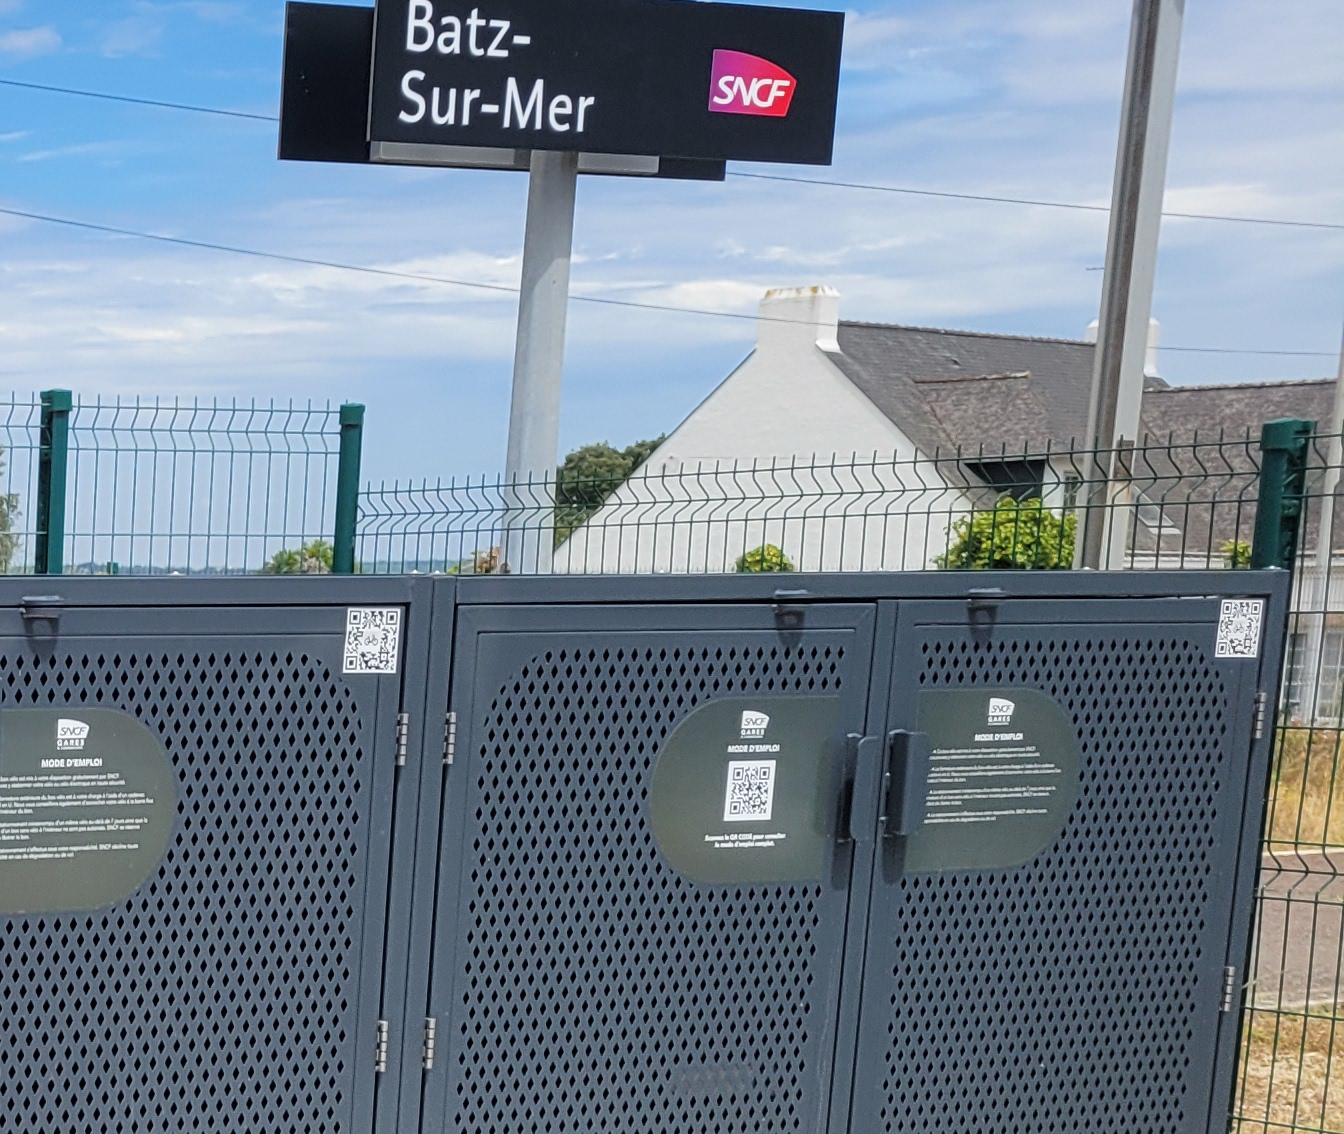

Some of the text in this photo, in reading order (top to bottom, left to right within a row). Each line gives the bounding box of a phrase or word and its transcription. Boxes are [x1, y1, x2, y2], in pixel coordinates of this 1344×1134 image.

[406, 0, 532, 57] Batz-
[399, 69, 595, 133] Sur-Mer
[713, 75, 791, 108] SNCF
[59, 726, 87, 736] SNCF
[744, 717, 767, 726] SNCF
[41, 759, 65, 768] MODE
